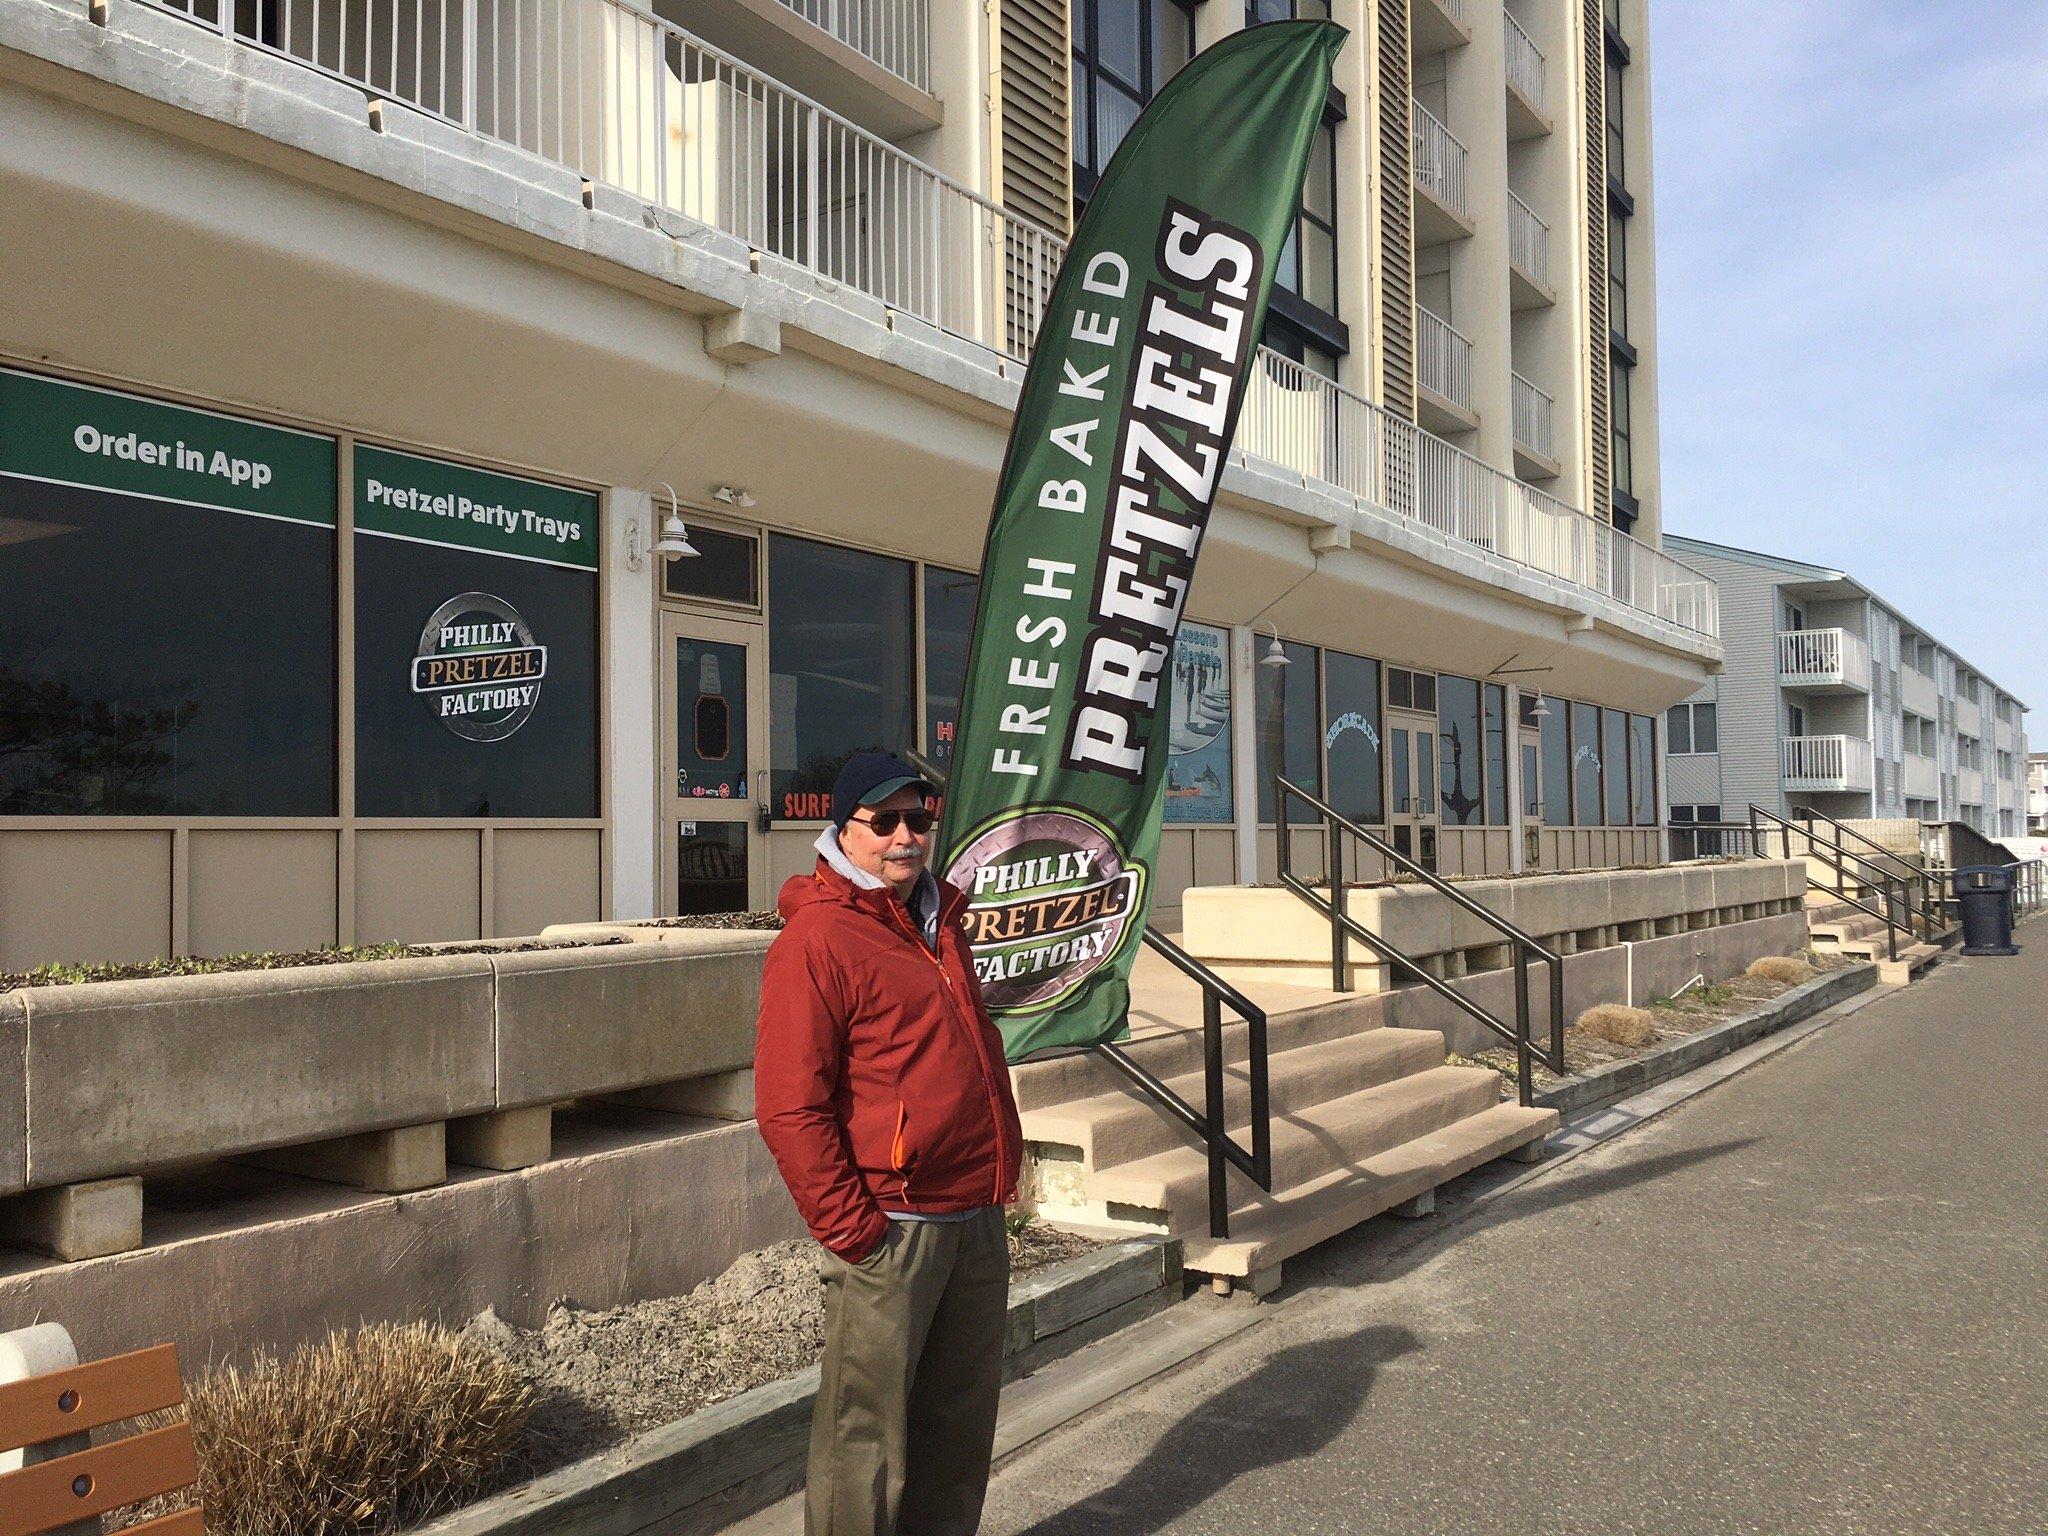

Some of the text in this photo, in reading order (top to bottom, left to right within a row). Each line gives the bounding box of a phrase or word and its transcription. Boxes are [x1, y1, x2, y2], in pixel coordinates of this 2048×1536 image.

[74, 425, 272, 489] Order in App
[367, 479, 581, 543] Pretzel Party Trays
[991, 251, 1129, 776] FRESH BAKED
[1070, 211, 1253, 775] PRETZELS
[440, 622, 515, 648] PHILLY
[428, 652, 536, 685] PRETZEL
[440, 686, 534, 716] FACTORY
[973, 849, 1098, 894] PHILLY
